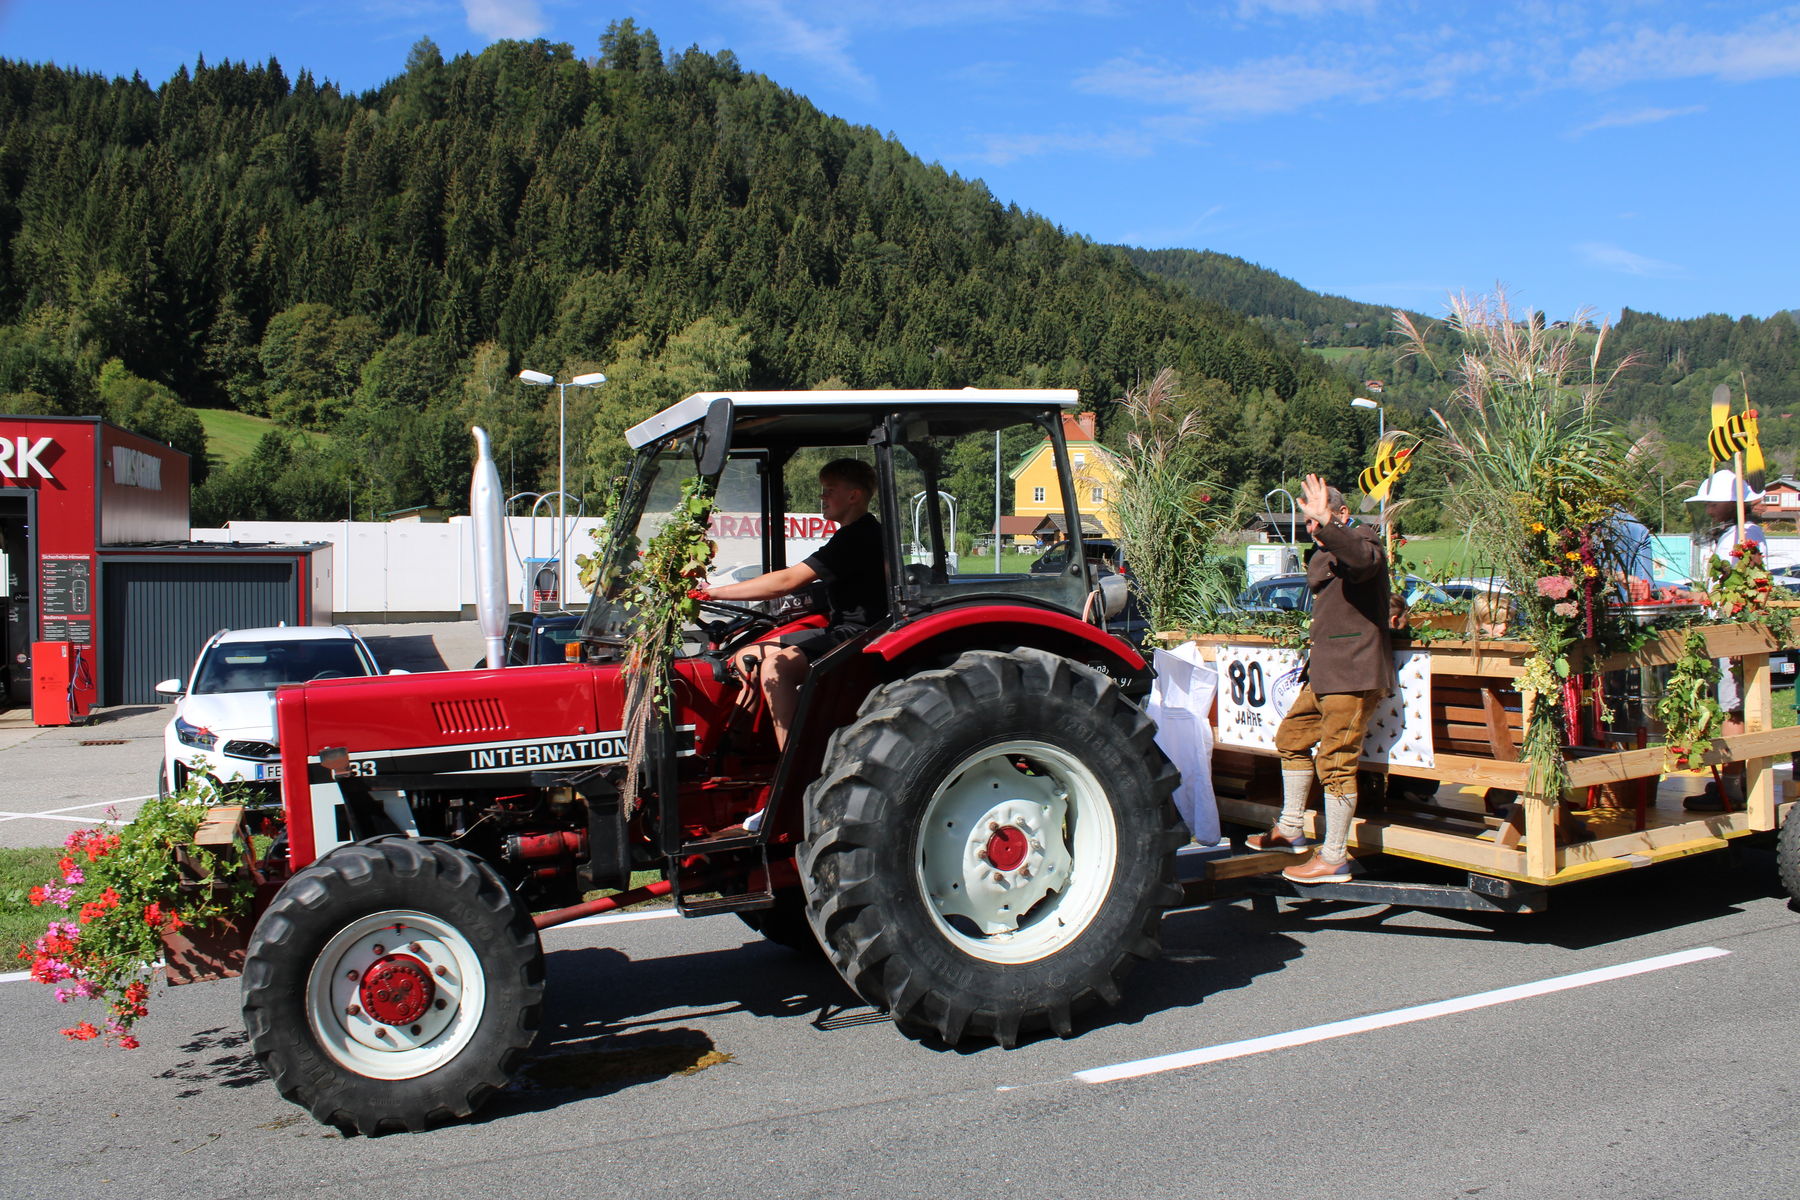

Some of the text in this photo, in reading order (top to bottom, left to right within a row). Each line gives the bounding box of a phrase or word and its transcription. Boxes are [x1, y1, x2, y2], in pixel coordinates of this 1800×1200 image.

[1228, 660, 1266, 708] 80
[1235, 711, 1262, 727] JAHRE
[470, 738, 628, 769] INTERNATION
[331, 760, 377, 779] 33
